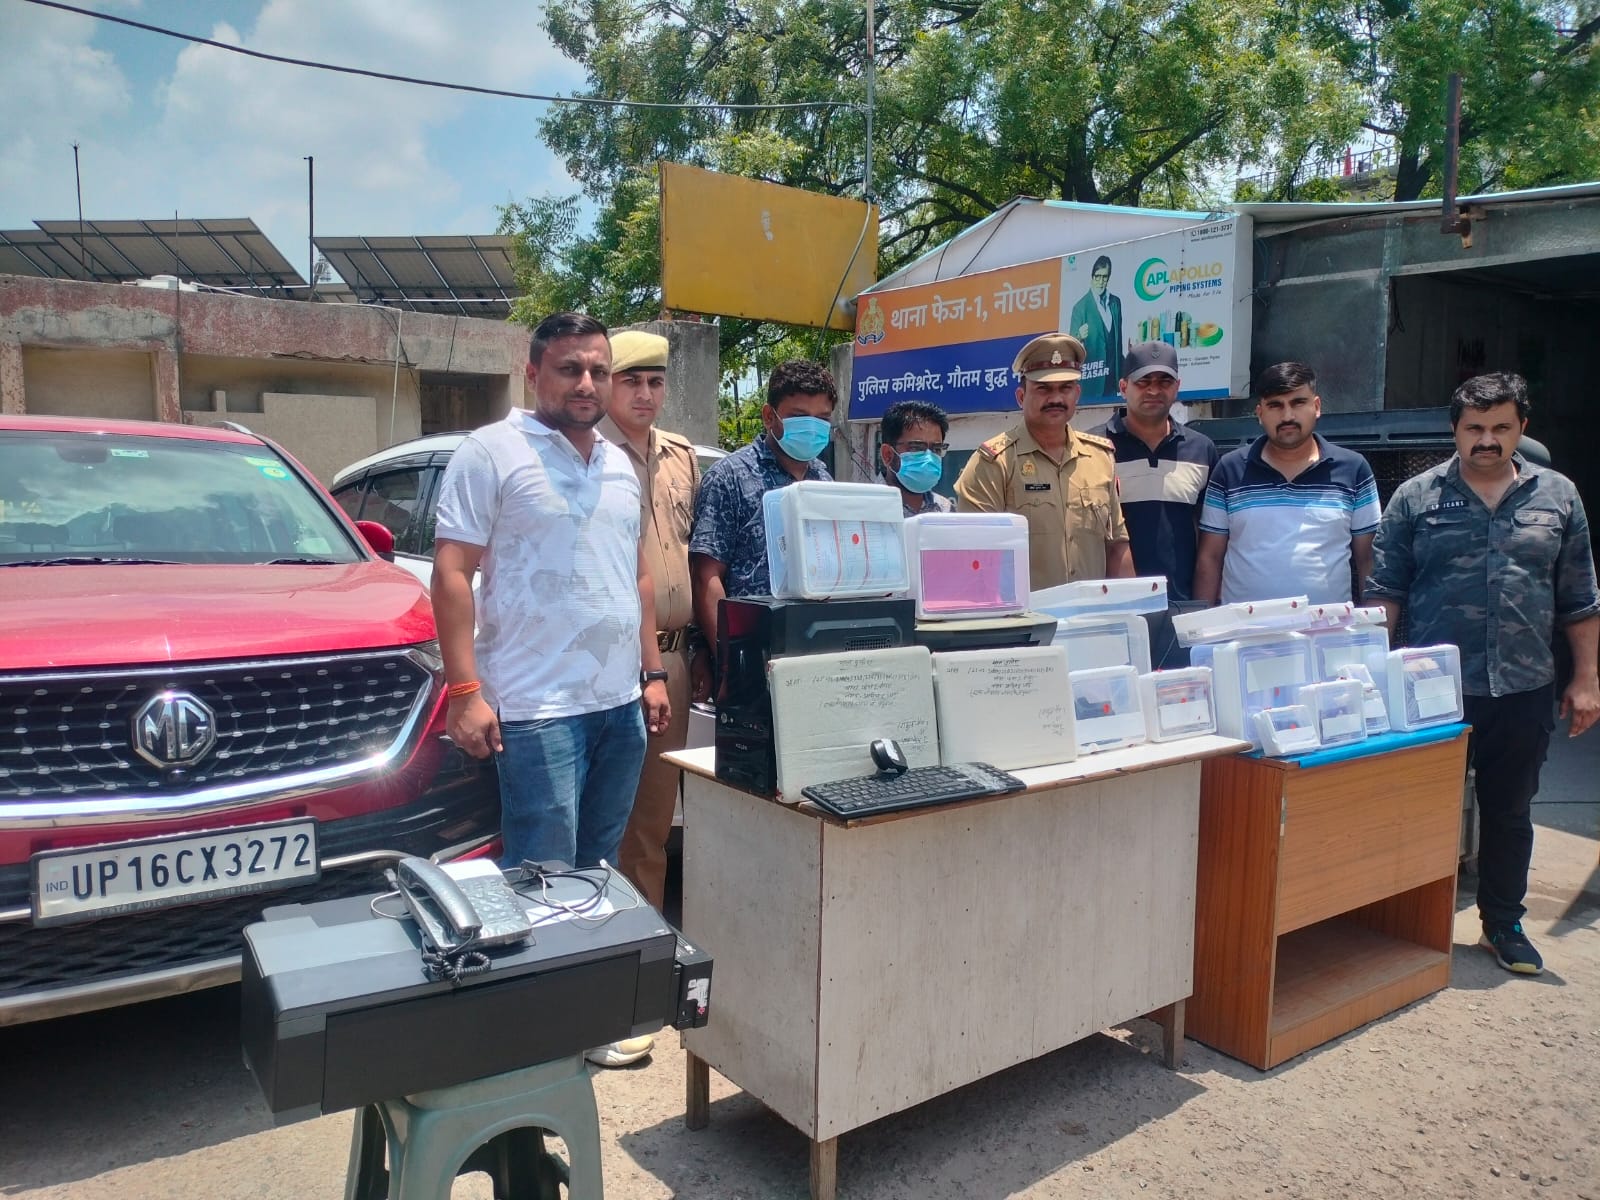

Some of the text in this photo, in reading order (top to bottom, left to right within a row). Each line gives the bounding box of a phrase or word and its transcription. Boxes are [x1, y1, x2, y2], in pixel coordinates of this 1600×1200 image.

[1146, 262, 1223, 287] APL APOLLO
[1169, 279, 1222, 293] PIPING SYSTEMS
[891, 304, 928, 330] थाना
[993, 282, 1051, 314] नोएडा
[858, 375, 890, 402] पुलिस
[947, 365, 981, 389] गौतम
[984, 367, 1009, 392] बुद्ध
[1077, 367, 1110, 380] EASAR
[144, 699, 209, 760] MG
[72, 833, 311, 900] UP16CX3272
[46, 881, 69, 893] IND
